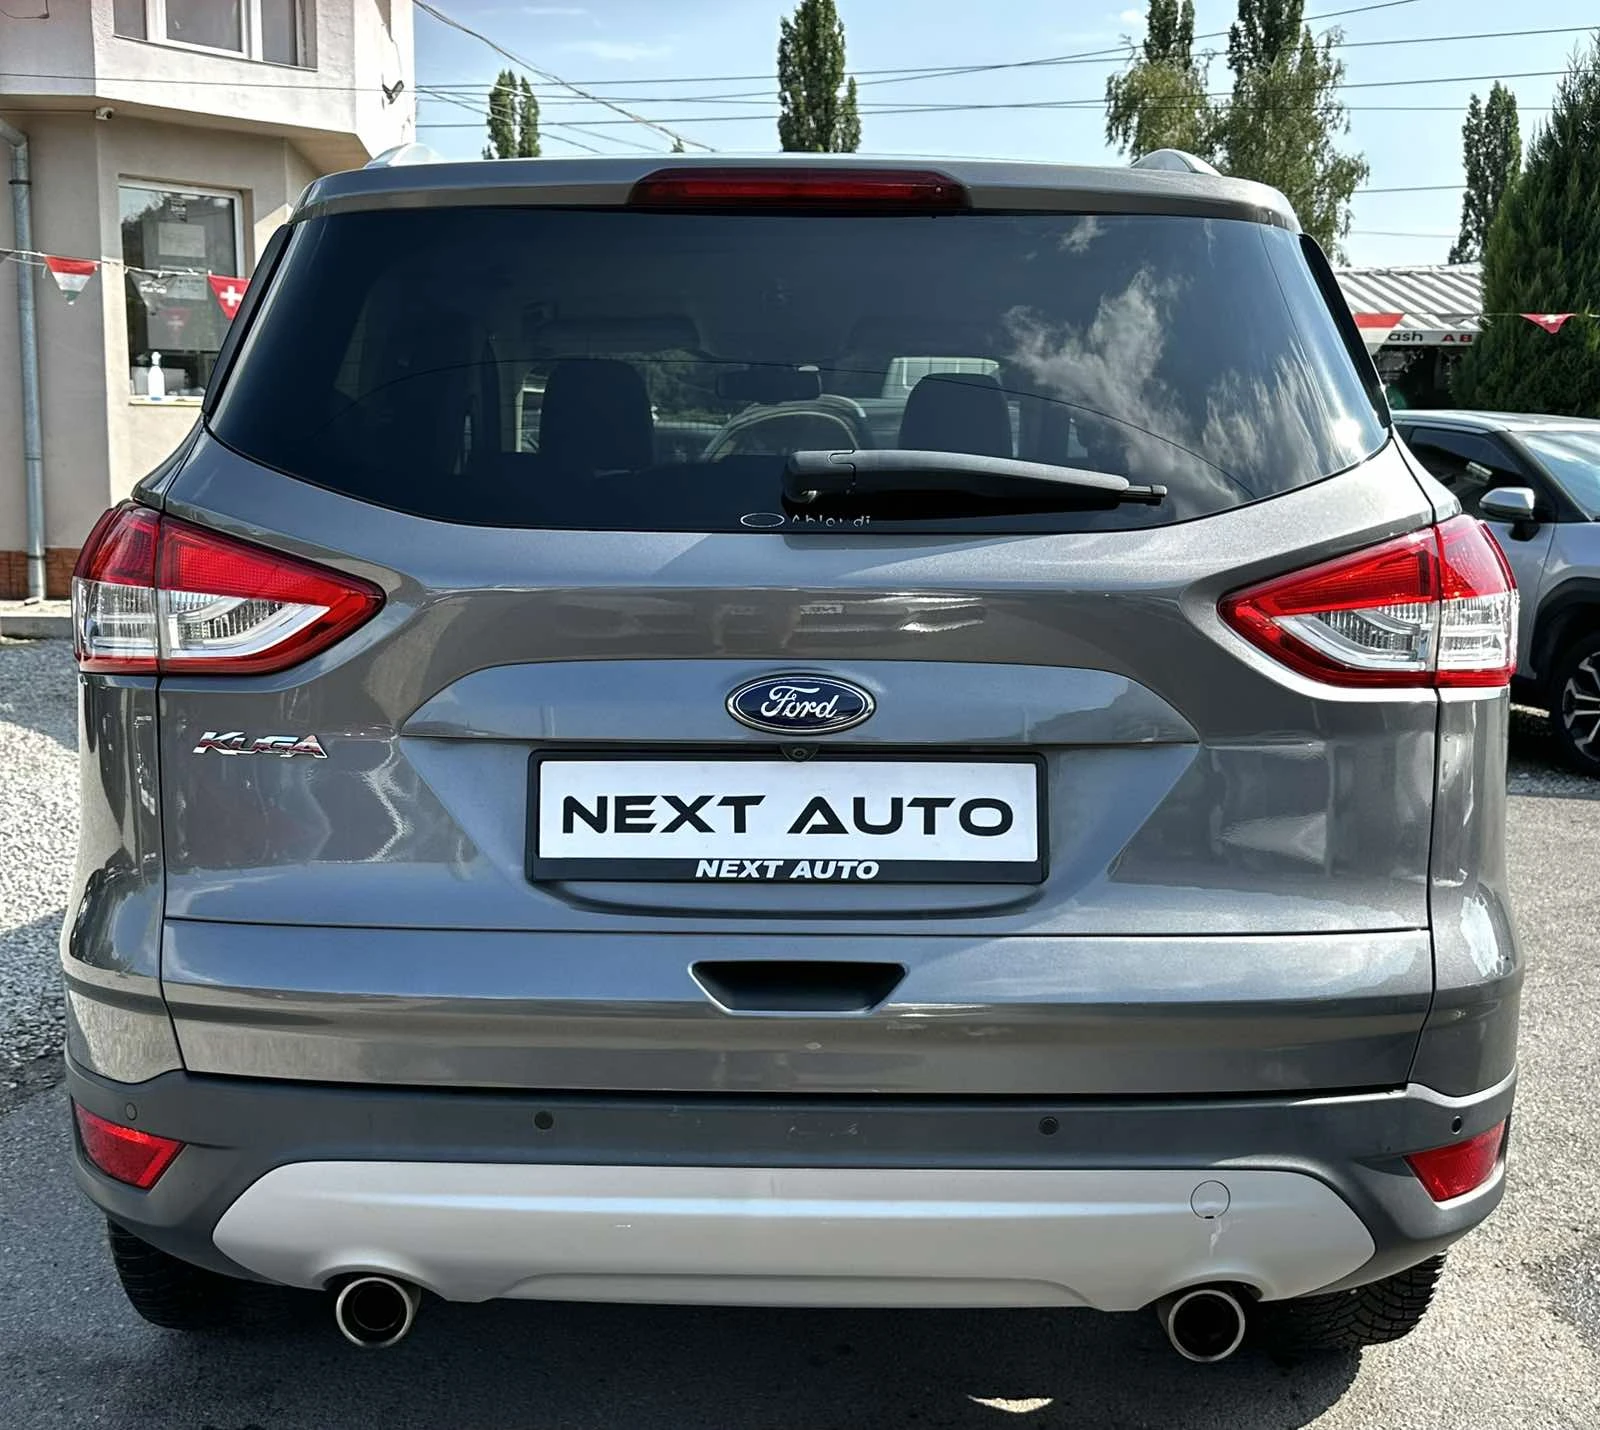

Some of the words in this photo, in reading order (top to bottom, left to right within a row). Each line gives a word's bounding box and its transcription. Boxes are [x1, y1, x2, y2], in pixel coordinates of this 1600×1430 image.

[1387, 331, 1423, 341] ash
[761, 684, 838, 720] Ford
[192, 731, 328, 758] KUGA
[562, 794, 767, 835] NEXT
[786, 795, 1014, 837] AUTO
[694, 859, 784, 879] NEXT
[789, 859, 880, 880] AUTO
